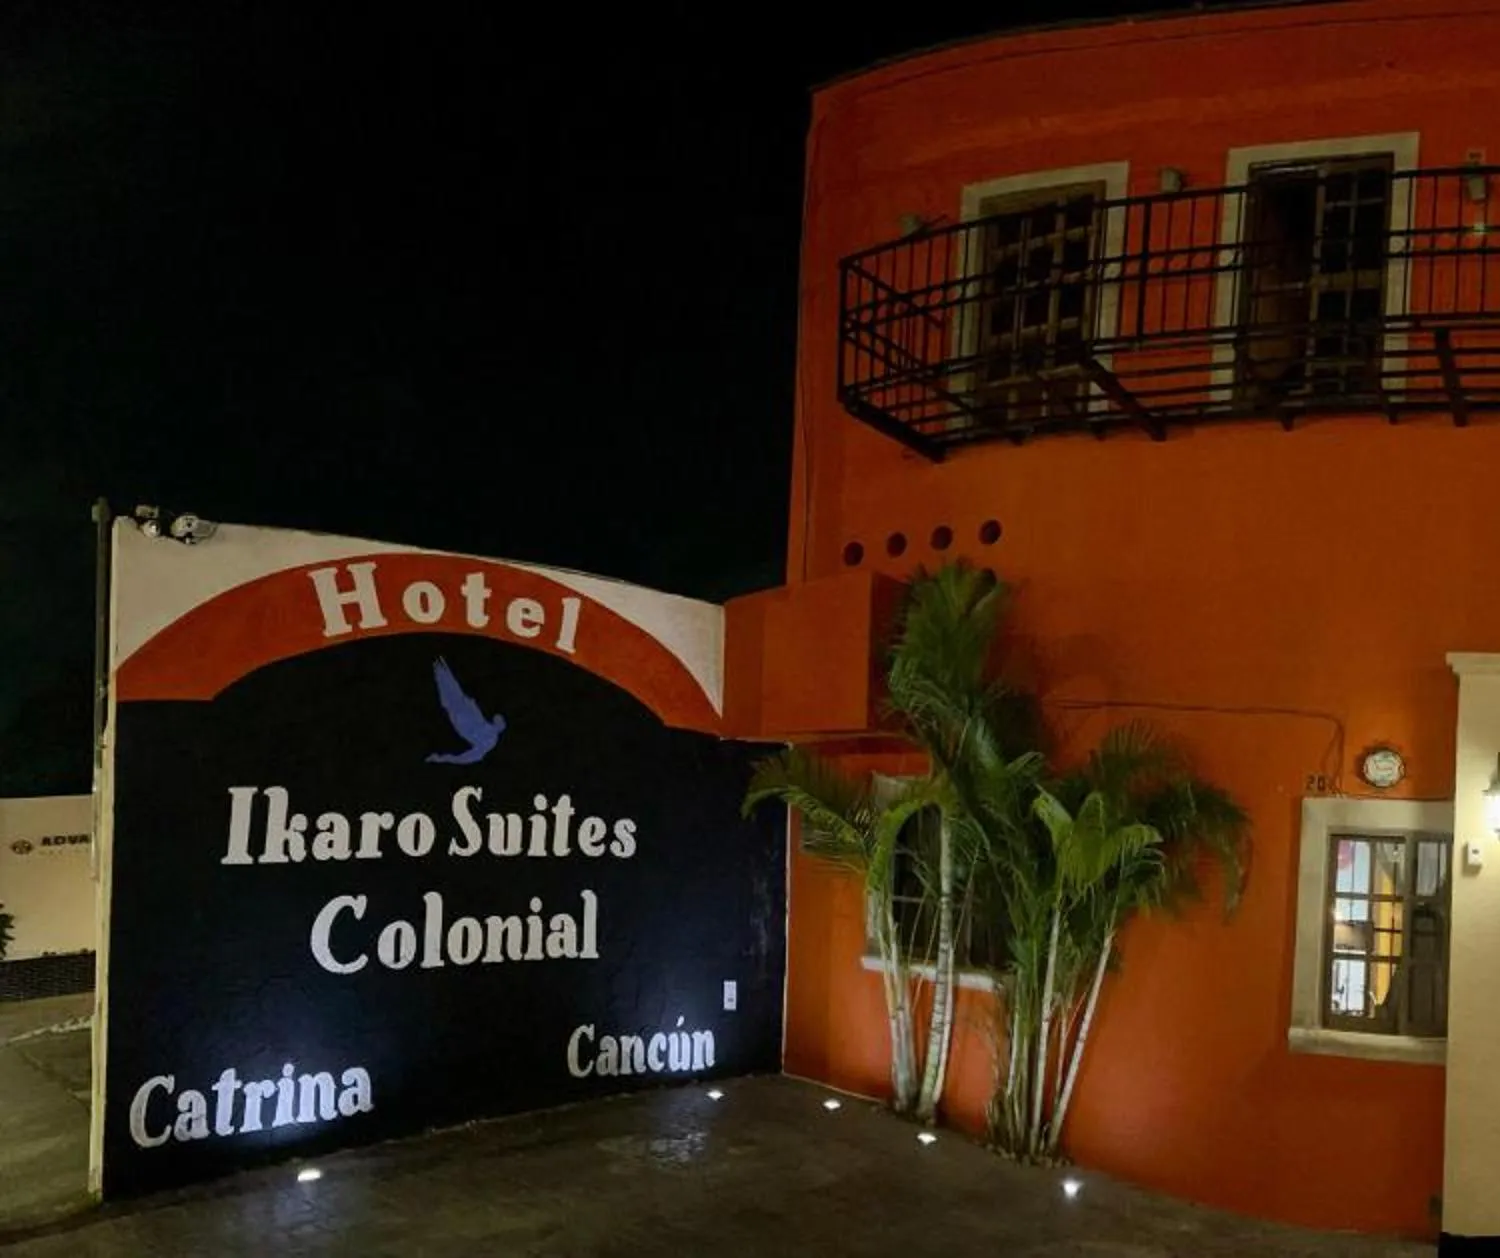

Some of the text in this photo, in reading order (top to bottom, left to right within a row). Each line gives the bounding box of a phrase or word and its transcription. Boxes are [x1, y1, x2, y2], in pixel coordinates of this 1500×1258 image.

[307, 561, 582, 655] Hotel
[221, 785, 638, 865] Ikaro Suites
[310, 889, 600, 975] Colonial
[567, 1016, 715, 1079] Cancún
[129, 1062, 374, 1150] Catrina
